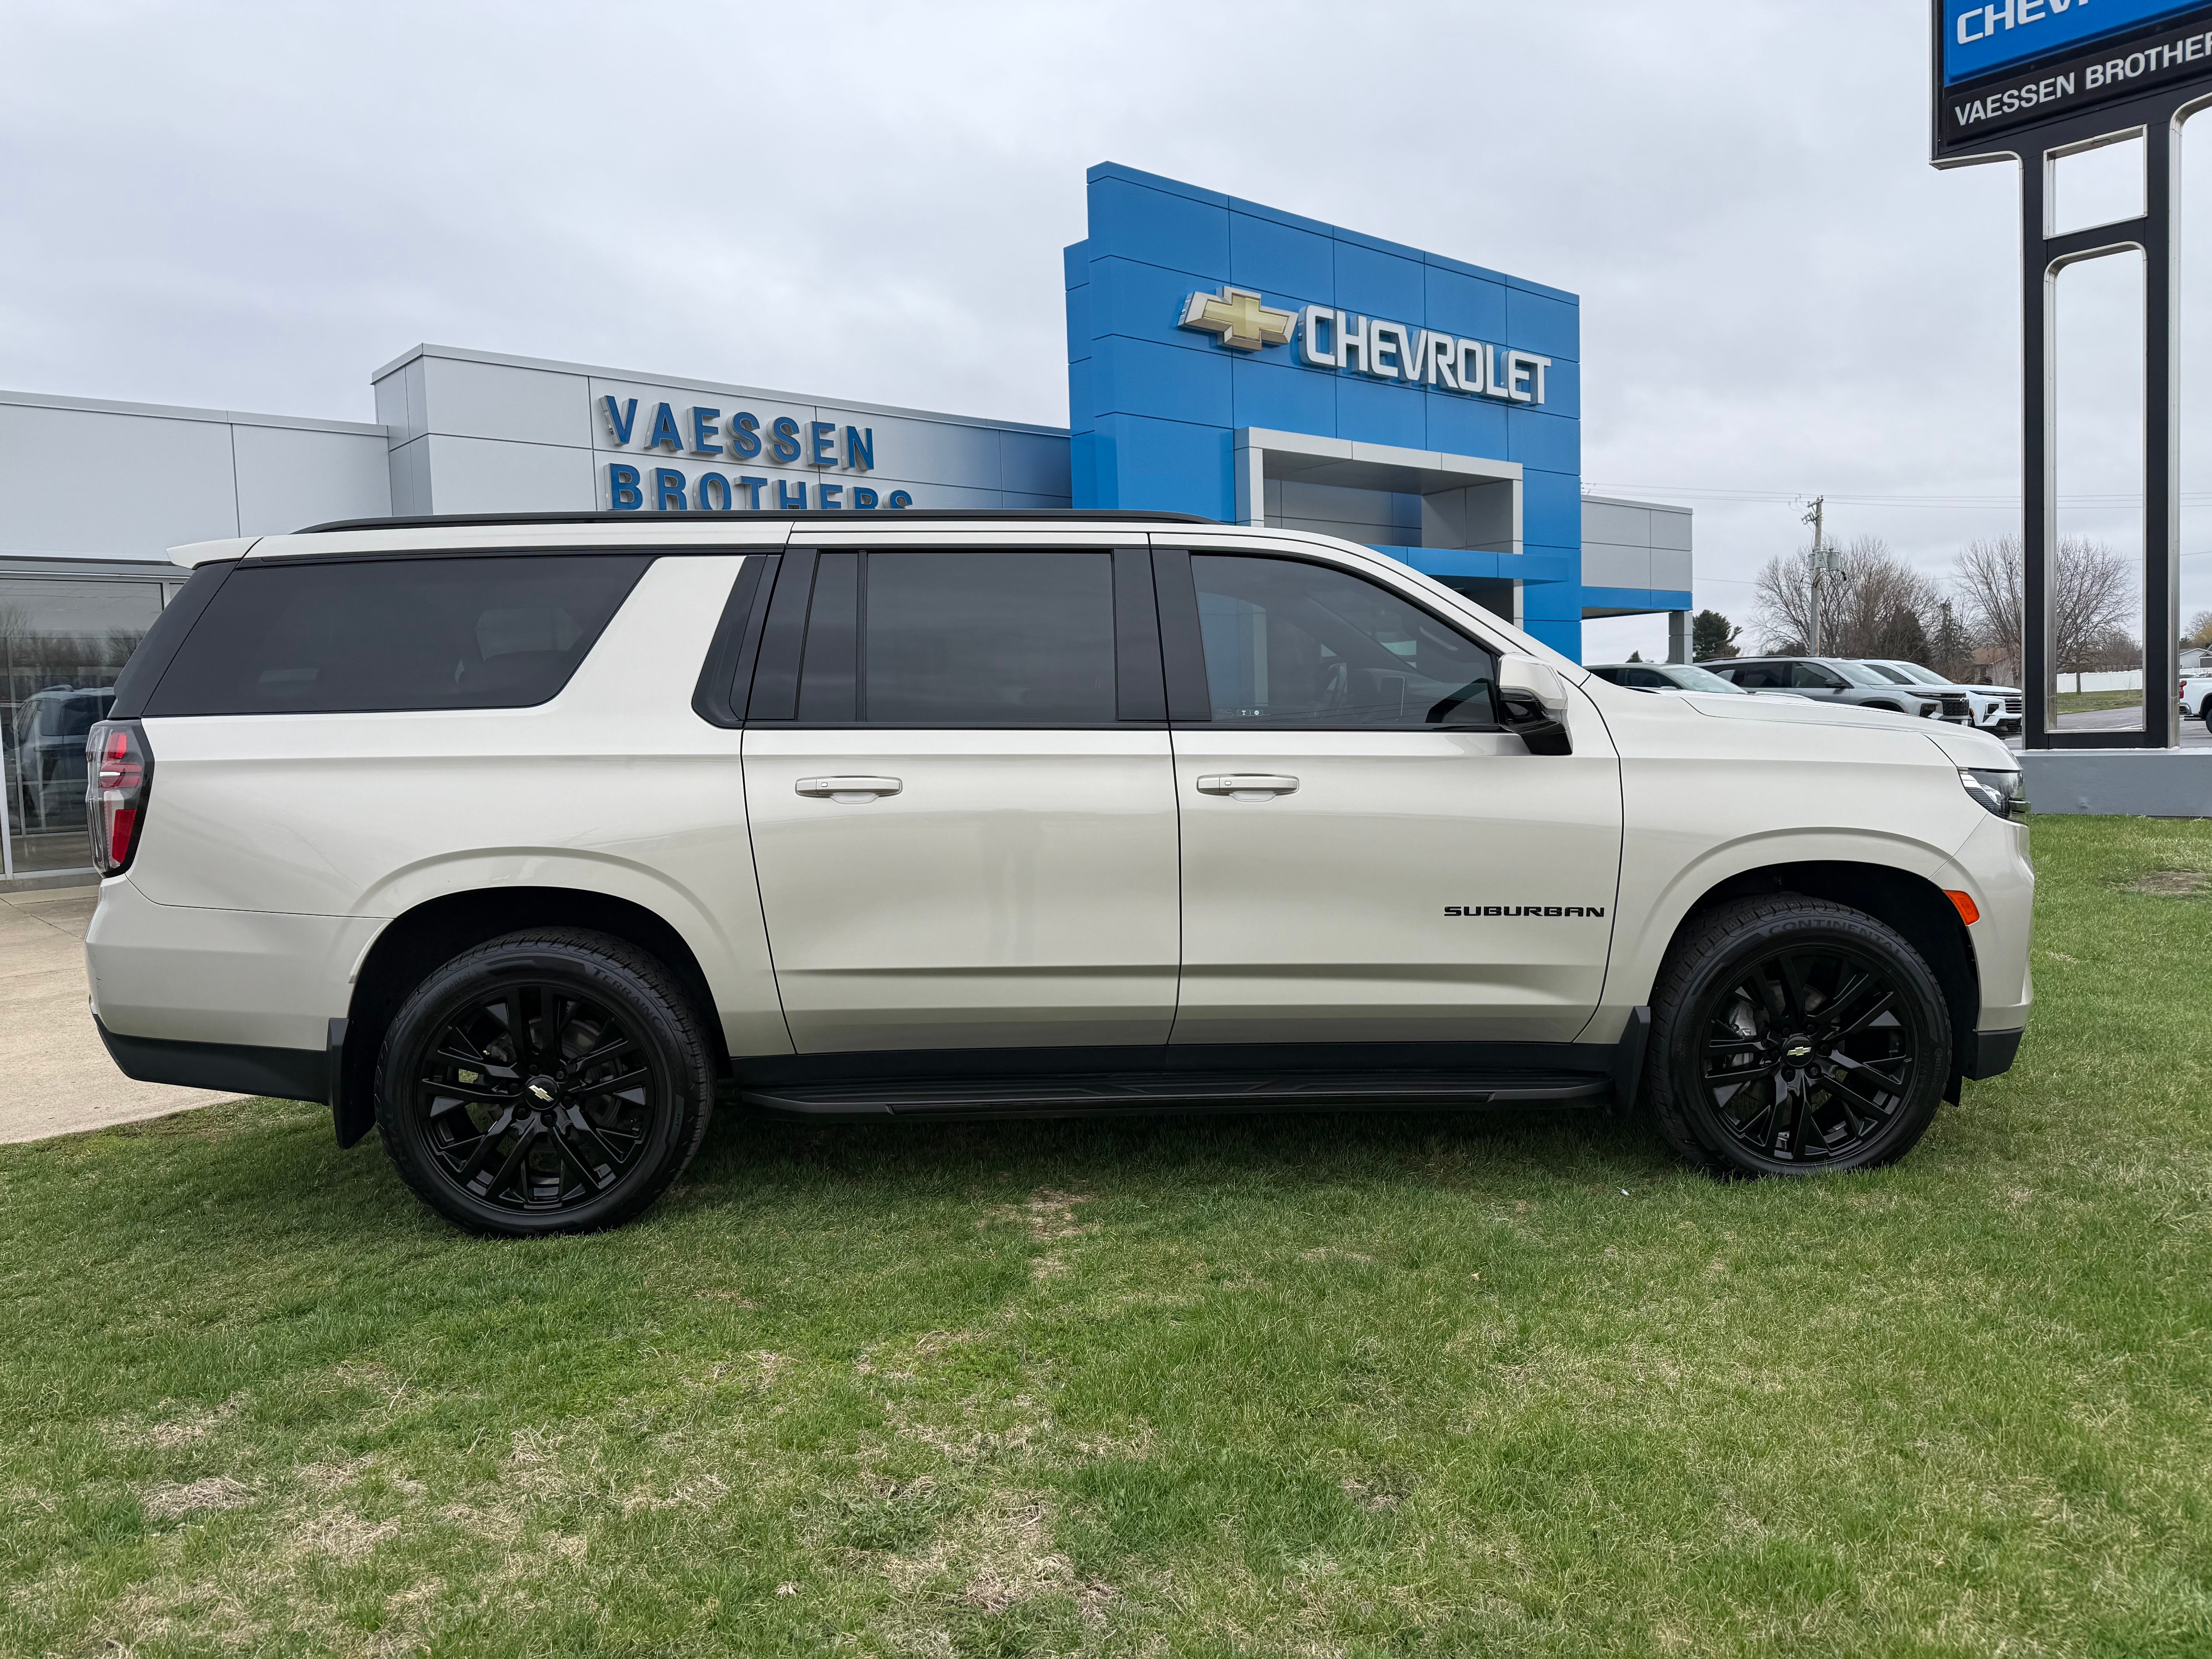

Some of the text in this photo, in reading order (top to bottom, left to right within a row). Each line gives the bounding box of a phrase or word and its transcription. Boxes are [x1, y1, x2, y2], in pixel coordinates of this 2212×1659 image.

[1955, 72, 2075, 126] VAESSEN
[1299, 305, 1551, 405] CHEVROLET
[600, 395, 874, 471] VAESSEN
[1444, 906, 1605, 917] SUBURBAN
[1769, 919, 1901, 955] CONTINENTAL
